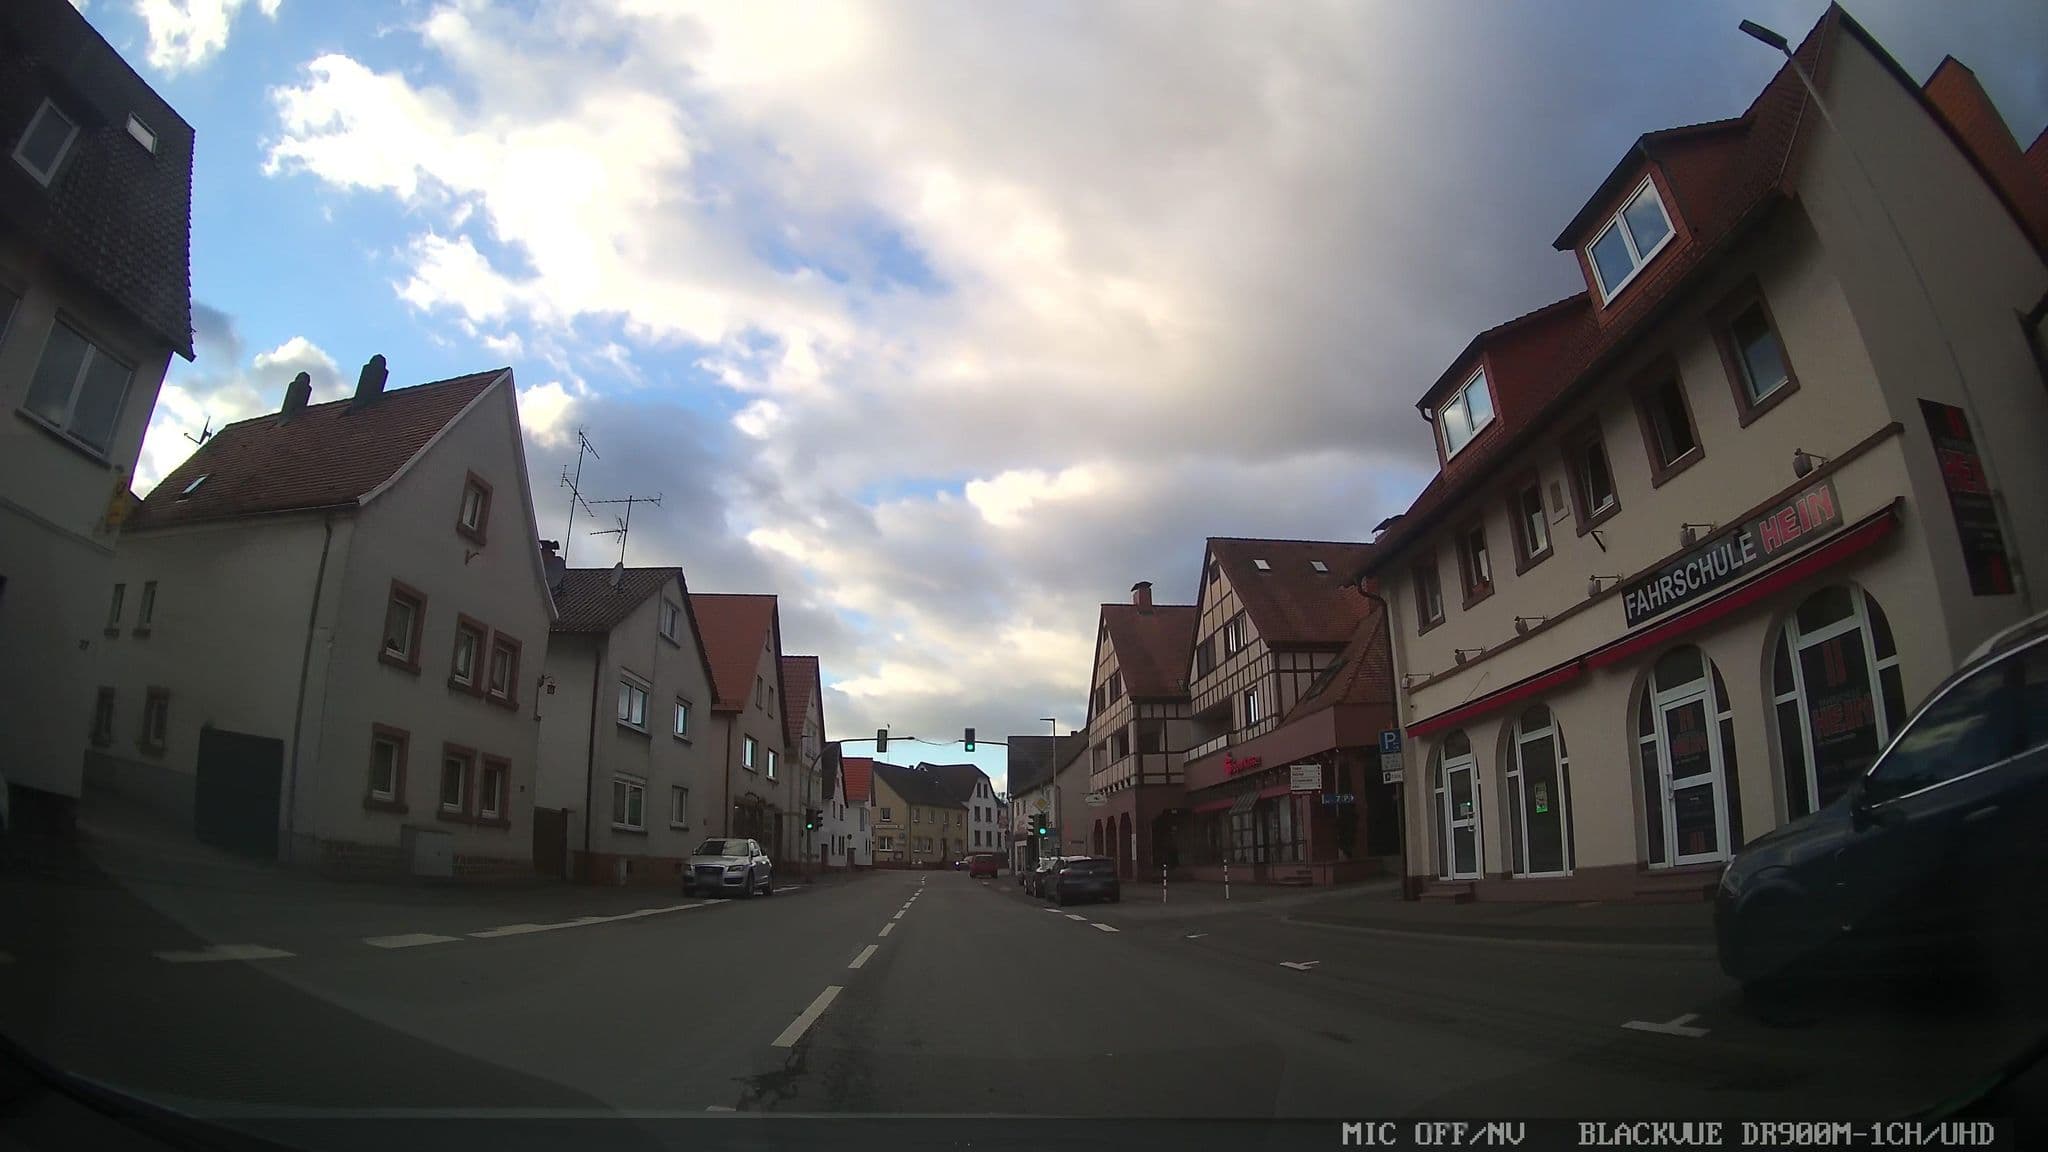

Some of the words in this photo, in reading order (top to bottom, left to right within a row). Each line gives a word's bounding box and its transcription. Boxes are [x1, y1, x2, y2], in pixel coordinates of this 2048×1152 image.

[1625, 531, 1757, 620] FAHRSCHULE
[1759, 484, 1836, 554] HEIN
[1384, 732, 1396, 750] P
